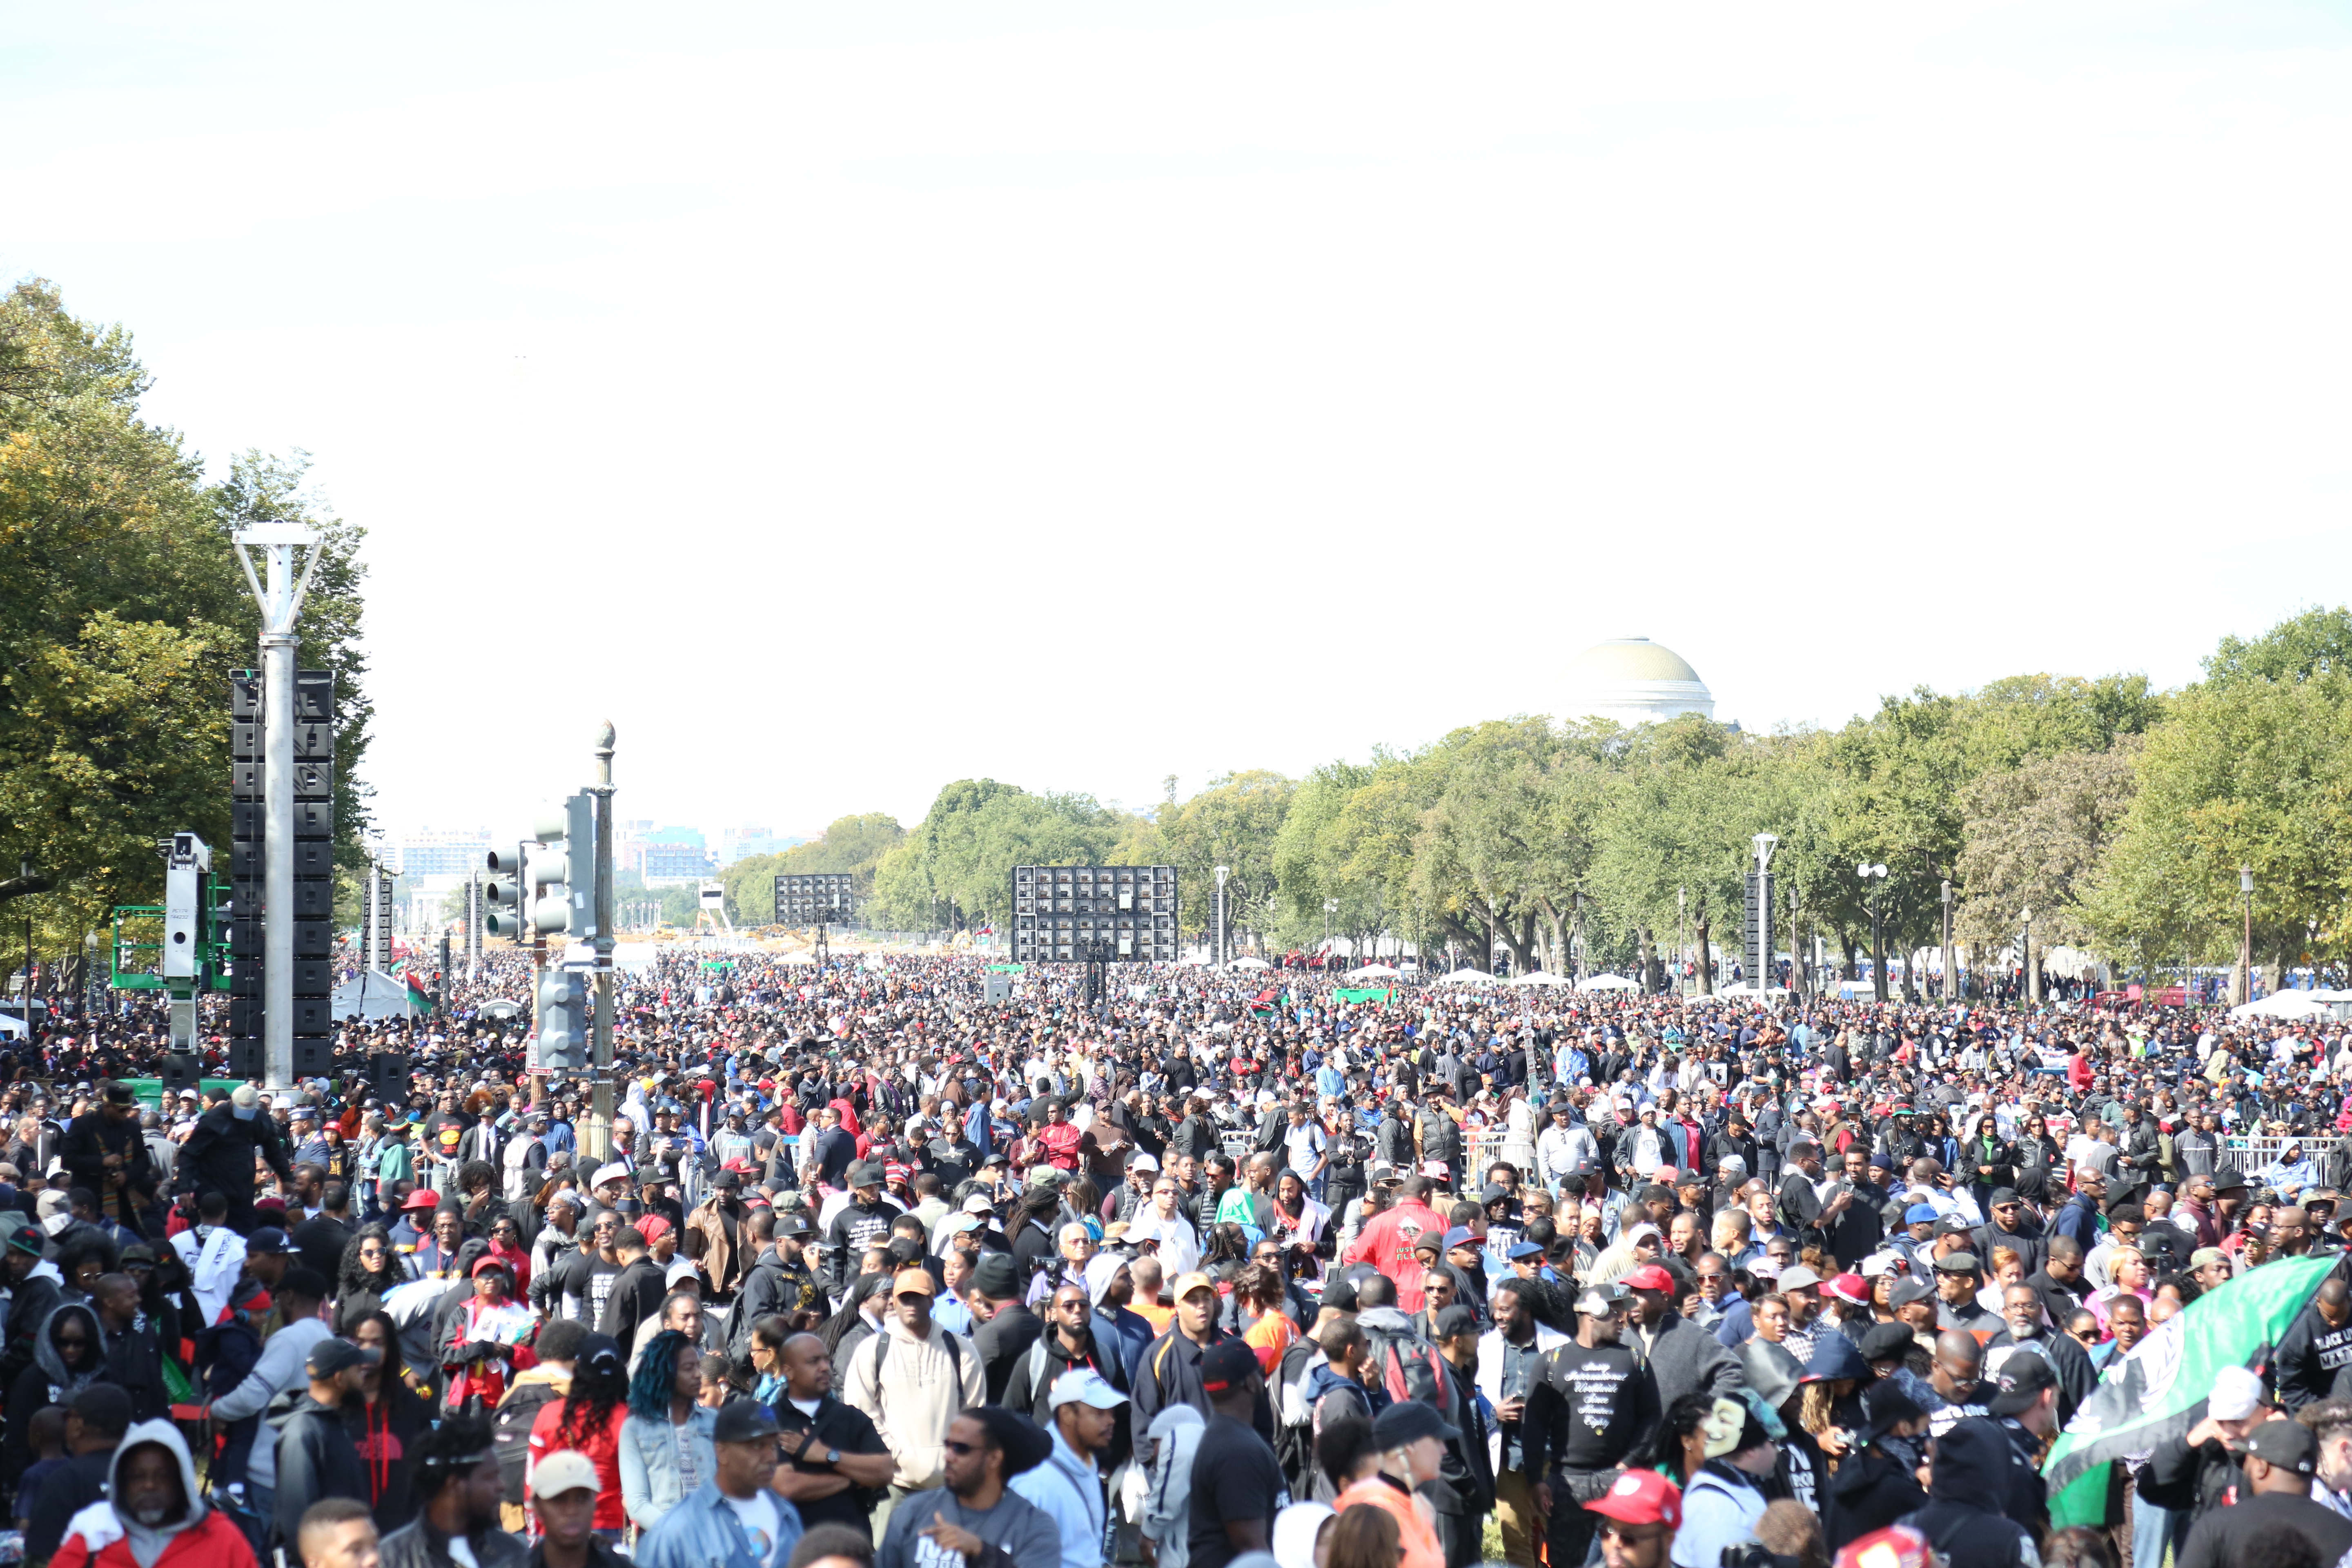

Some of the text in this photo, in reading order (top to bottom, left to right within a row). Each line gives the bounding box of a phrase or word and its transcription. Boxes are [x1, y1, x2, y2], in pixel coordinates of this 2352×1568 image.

[1564, 1371, 1628, 1381] International
[1574, 1381, 1618, 1393] Worldwide
[1584, 1393, 1609, 1404] Since
[1577, 1403, 1614, 1415] Nineteen
[1584, 1414, 1610, 1429] Eighty
